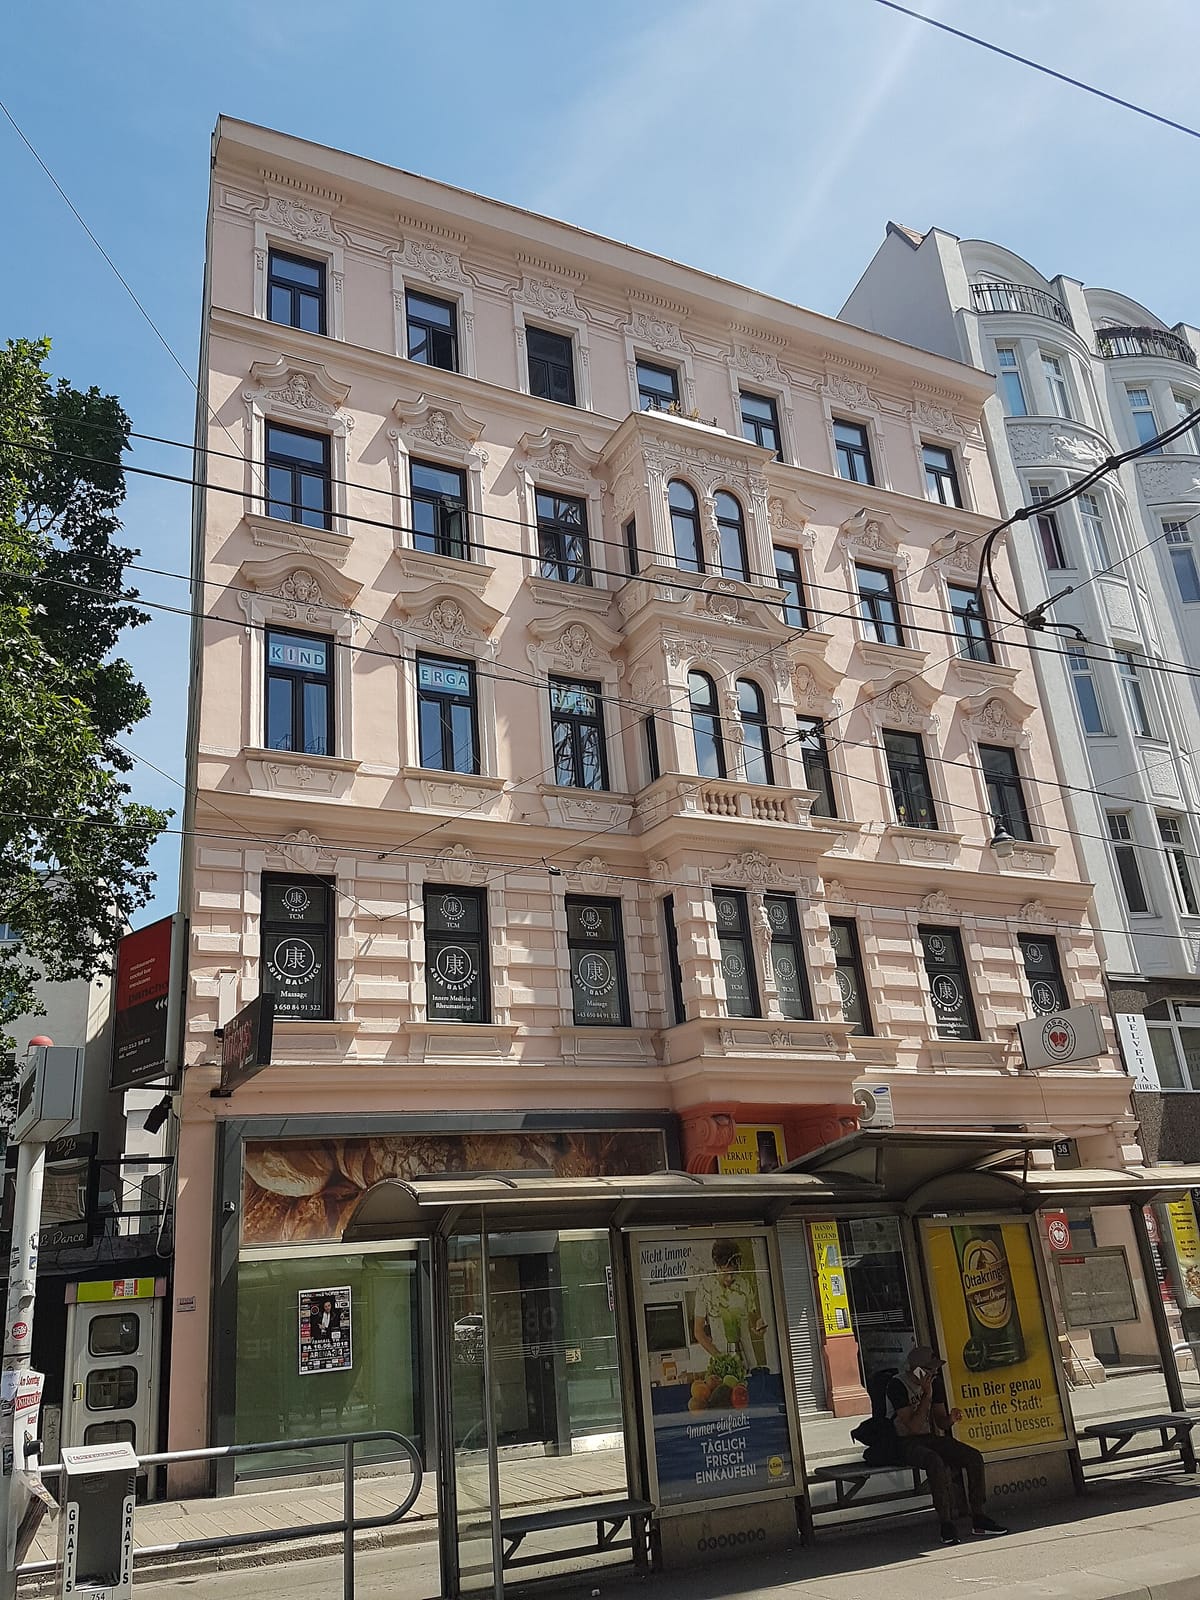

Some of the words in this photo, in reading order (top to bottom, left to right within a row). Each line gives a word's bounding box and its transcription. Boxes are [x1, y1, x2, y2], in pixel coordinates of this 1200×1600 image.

[271, 644, 325, 666] KIND
[421, 669, 468, 687] ERGA
[551, 691, 595, 709] RTEN
[283, 946, 306, 969] 康
[444, 953, 464, 975] 康
[266, 961, 283, 981] ASIA
[285, 963, 322, 986] BALANCE
[430, 967, 444, 987] ASIA
[446, 969, 478, 991] BALANCE
[586, 961, 604, 981] 康
[280, 990, 308, 999] Massage
[573, 973, 587, 992] ASIA
[589, 976, 617, 996] BALANCE
[939, 981, 955, 999] 康
[943, 993, 964, 1012] BALANCE
[1044, 1019, 1069, 1034] TOSAN
[1126, 1015, 1149, 1082] HELVETIA
[53, 1230, 85, 1245] Dance
[640, 1248, 663, 1265] Nicht
[664, 1246, 692, 1261] immer
[650, 1262, 687, 1280] einfach?
[964, 1267, 1005, 1290] Ottakring
[816, 1242, 835, 1333] REPARATUR
[961, 1385, 981, 1399] Ein
[982, 1381, 1006, 1396] Bier
[1009, 1378, 1042, 1397] genau
[964, 1403, 986, 1419] wie
[990, 1400, 1008, 1416] die
[1010, 1395, 1043, 1413] Stadt:
[686, 1423, 716, 1439] Immer
[968, 1419, 1012, 1440] original
[1014, 1415, 1054, 1432] besser.
[700, 1436, 746, 1454] TÄGLICH
[705, 1451, 744, 1468] FRISCH
[695, 1463, 757, 1485] EINKAUFEN!
[65, 1509, 76, 1593] GRATIS
[122, 1502, 133, 1585] GRATIS
[90, 1592, 106, 1600] 754
